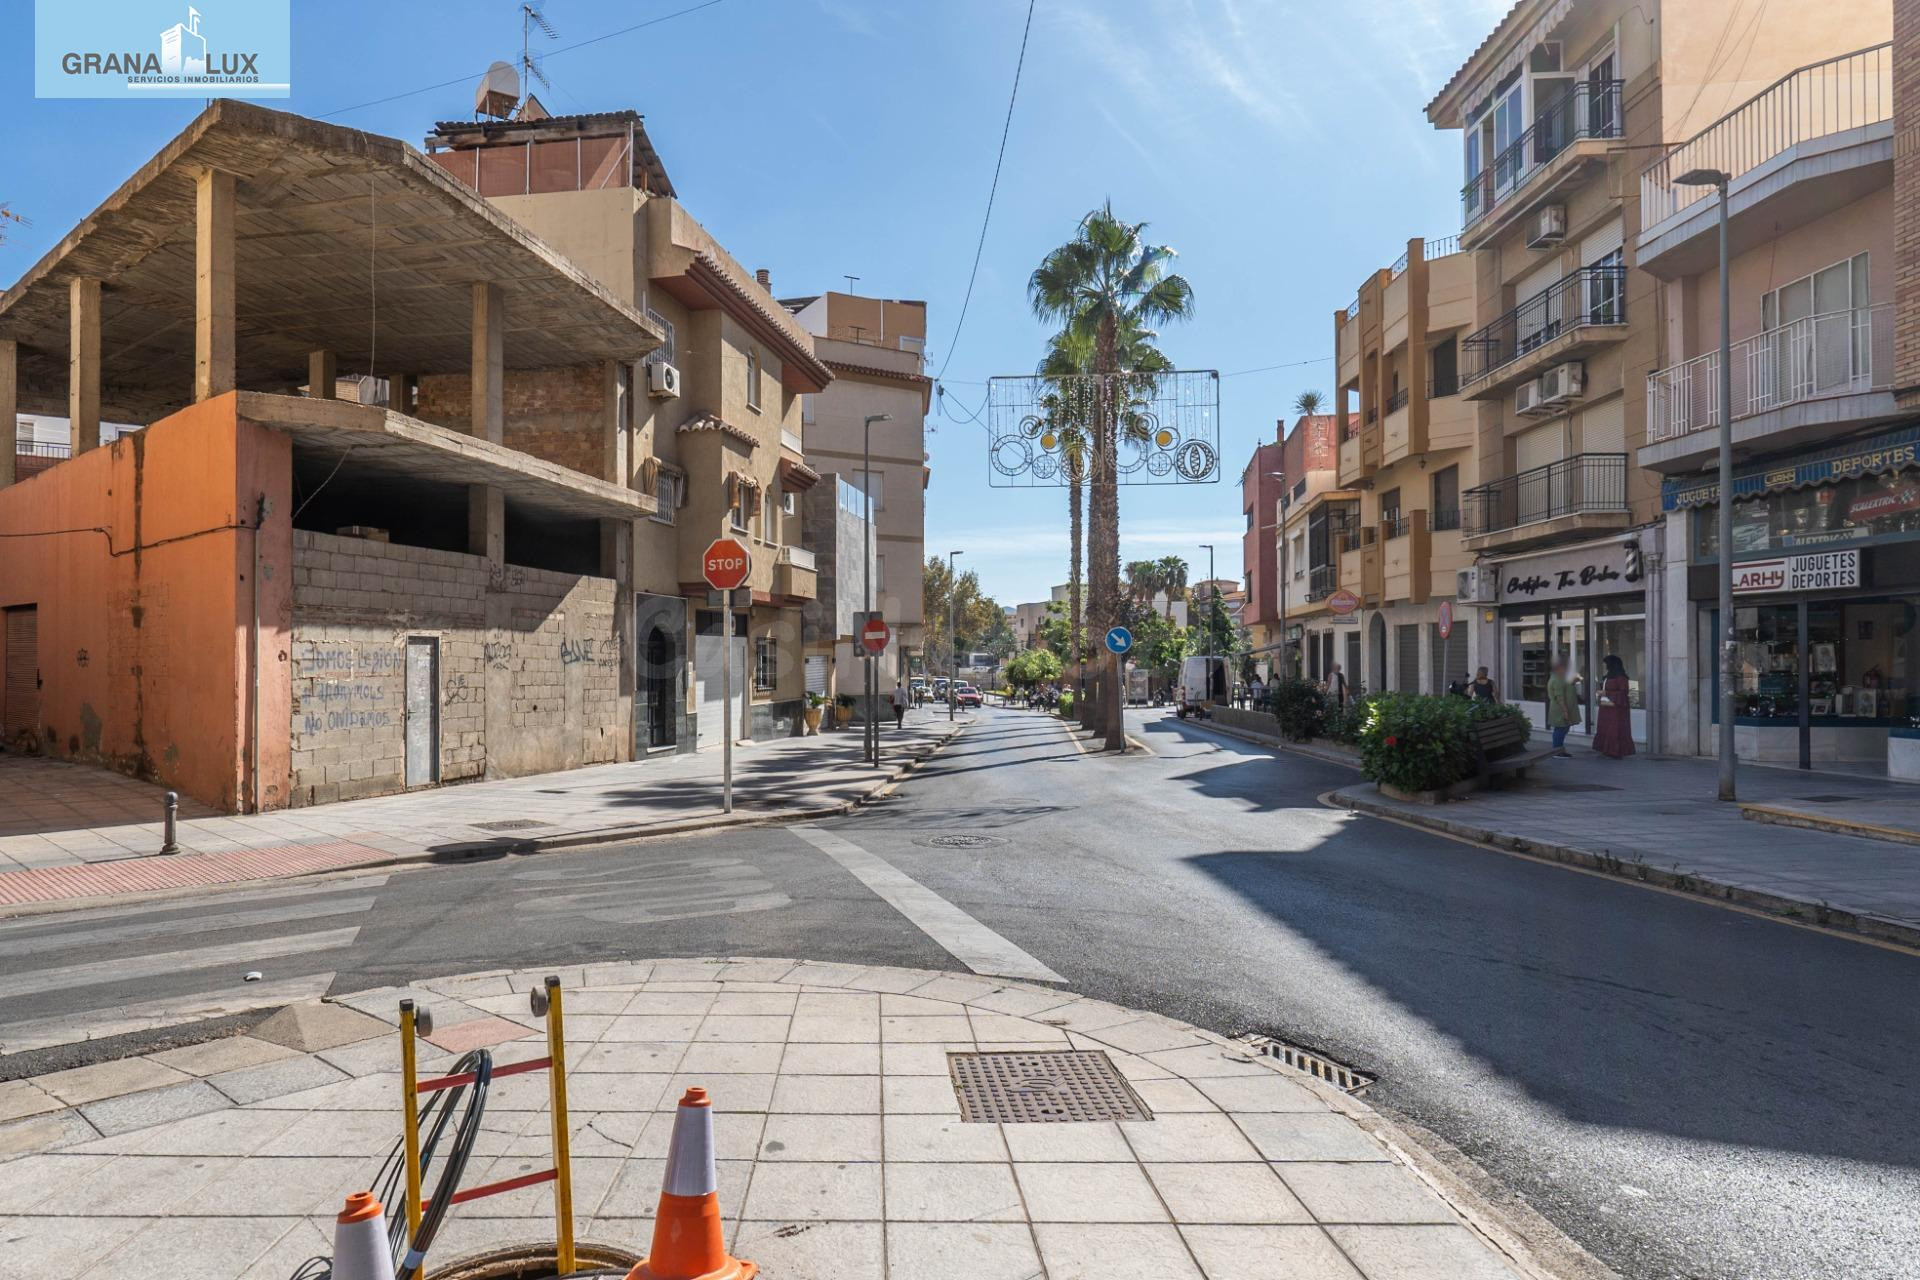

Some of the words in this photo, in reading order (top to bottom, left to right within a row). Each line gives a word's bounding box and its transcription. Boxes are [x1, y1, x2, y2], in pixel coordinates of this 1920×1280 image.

[1831, 446, 1916, 474] DEPORTES
[1676, 485, 1721, 505] JUGUETE
[707, 558, 744, 571] STOP
[1791, 552, 1856, 573] JUGUETES
[1791, 570, 1856, 589] DEPORTES
